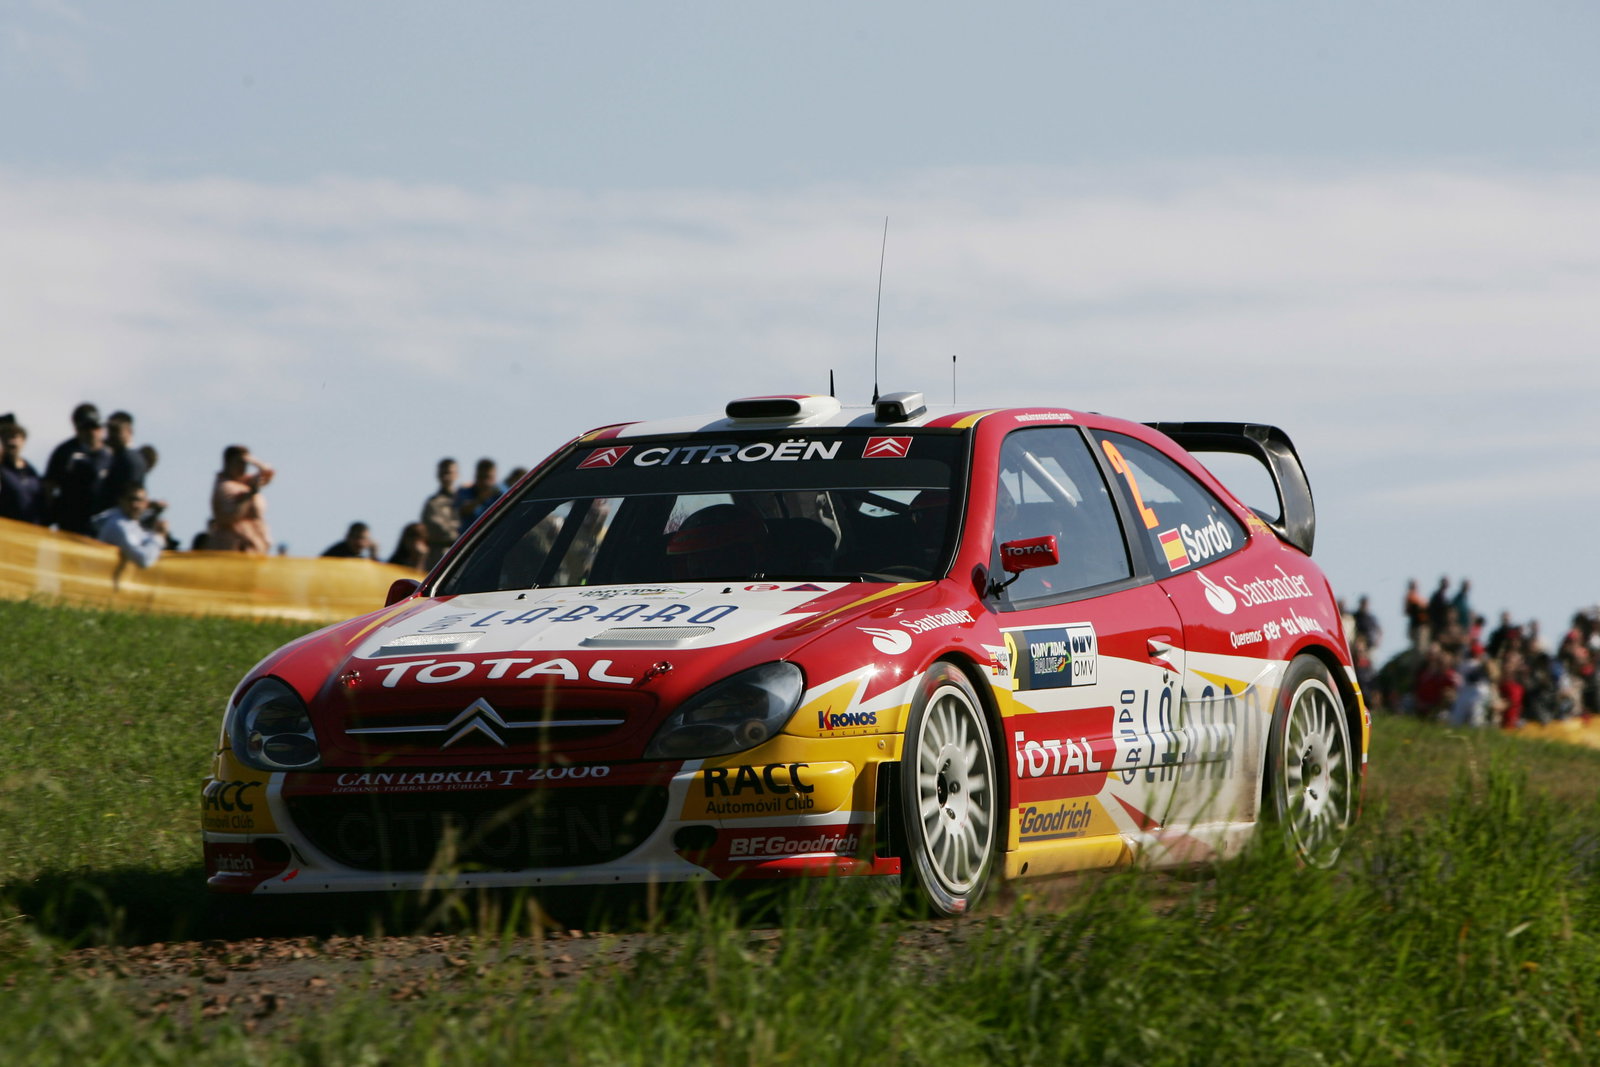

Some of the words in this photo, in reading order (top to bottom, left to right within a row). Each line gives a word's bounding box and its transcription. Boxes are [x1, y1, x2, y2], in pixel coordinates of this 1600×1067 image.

[633, 438, 842, 467] CITROËN
[1102, 440, 1160, 529] 2
[1005, 544, 1053, 557] TOTAL
[1180, 514, 1232, 563] Sordo
[1224, 564, 1313, 607] Santander
[899, 607, 976, 634] Santander
[1230, 630, 1263, 649] Queremos
[1263, 620, 1282, 641] ser
[1281, 616, 1300, 636] tu
[1003, 632, 1019, 690] 2
[1030, 642, 1050, 659] OMV
[376, 658, 635, 688] TOTAL
[1073, 659, 1094, 677] OMV
[818, 705, 878, 730] KRONOS
[819, 729, 879, 737] RACING
[1119, 689, 1142, 785] GRUPO
[704, 763, 814, 797] RACC
[203, 781, 263, 812] ACC
[705, 798, 781, 814] Automóvil
[786, 796, 814, 811] Club
[1019, 802, 1092, 834] Goodrich
